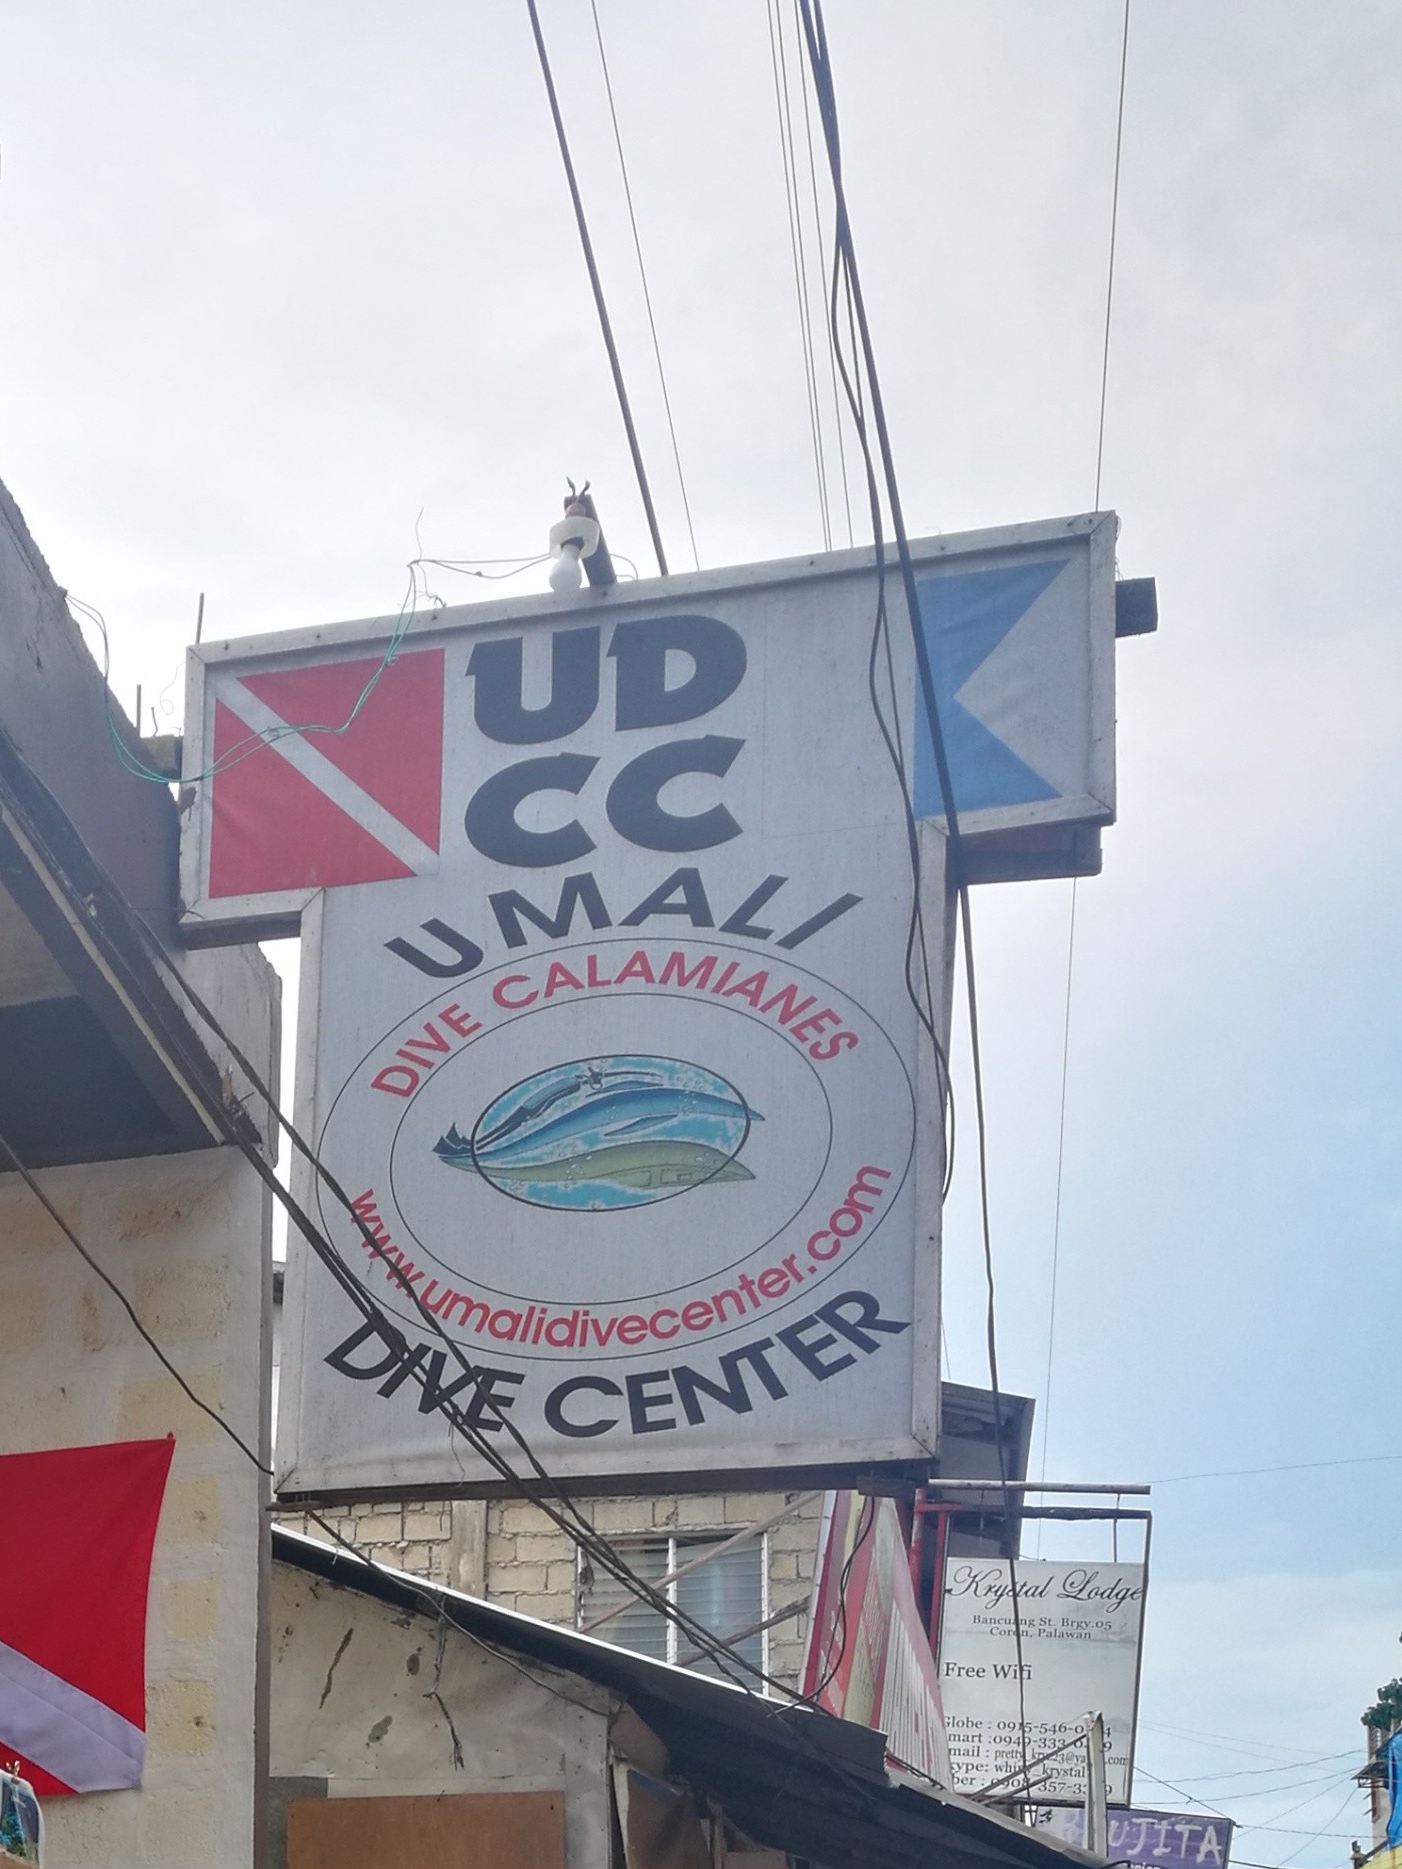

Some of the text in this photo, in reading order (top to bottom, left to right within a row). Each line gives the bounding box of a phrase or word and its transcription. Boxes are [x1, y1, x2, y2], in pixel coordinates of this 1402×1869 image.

[465, 615, 748, 745] UD
[465, 735, 745, 868] CC
[384, 867, 865, 979] UMALI
[371, 949, 859, 1100] DIVE CALAMIANES
[349, 1164, 892, 1349] www.umalidivecenter.com
[324, 1288, 911, 1438] DIVE CENTER
[1056, 1569, 1144, 1613] Lodge
[944, 1662, 1032, 1680] Free Wifi
[1038, 1629, 1092, 1639] Palawan
[948, 1733, 982, 1743] mart
[949, 1746, 980, 1757] mail
[1108, 1817, 1222, 1865] UJITA
